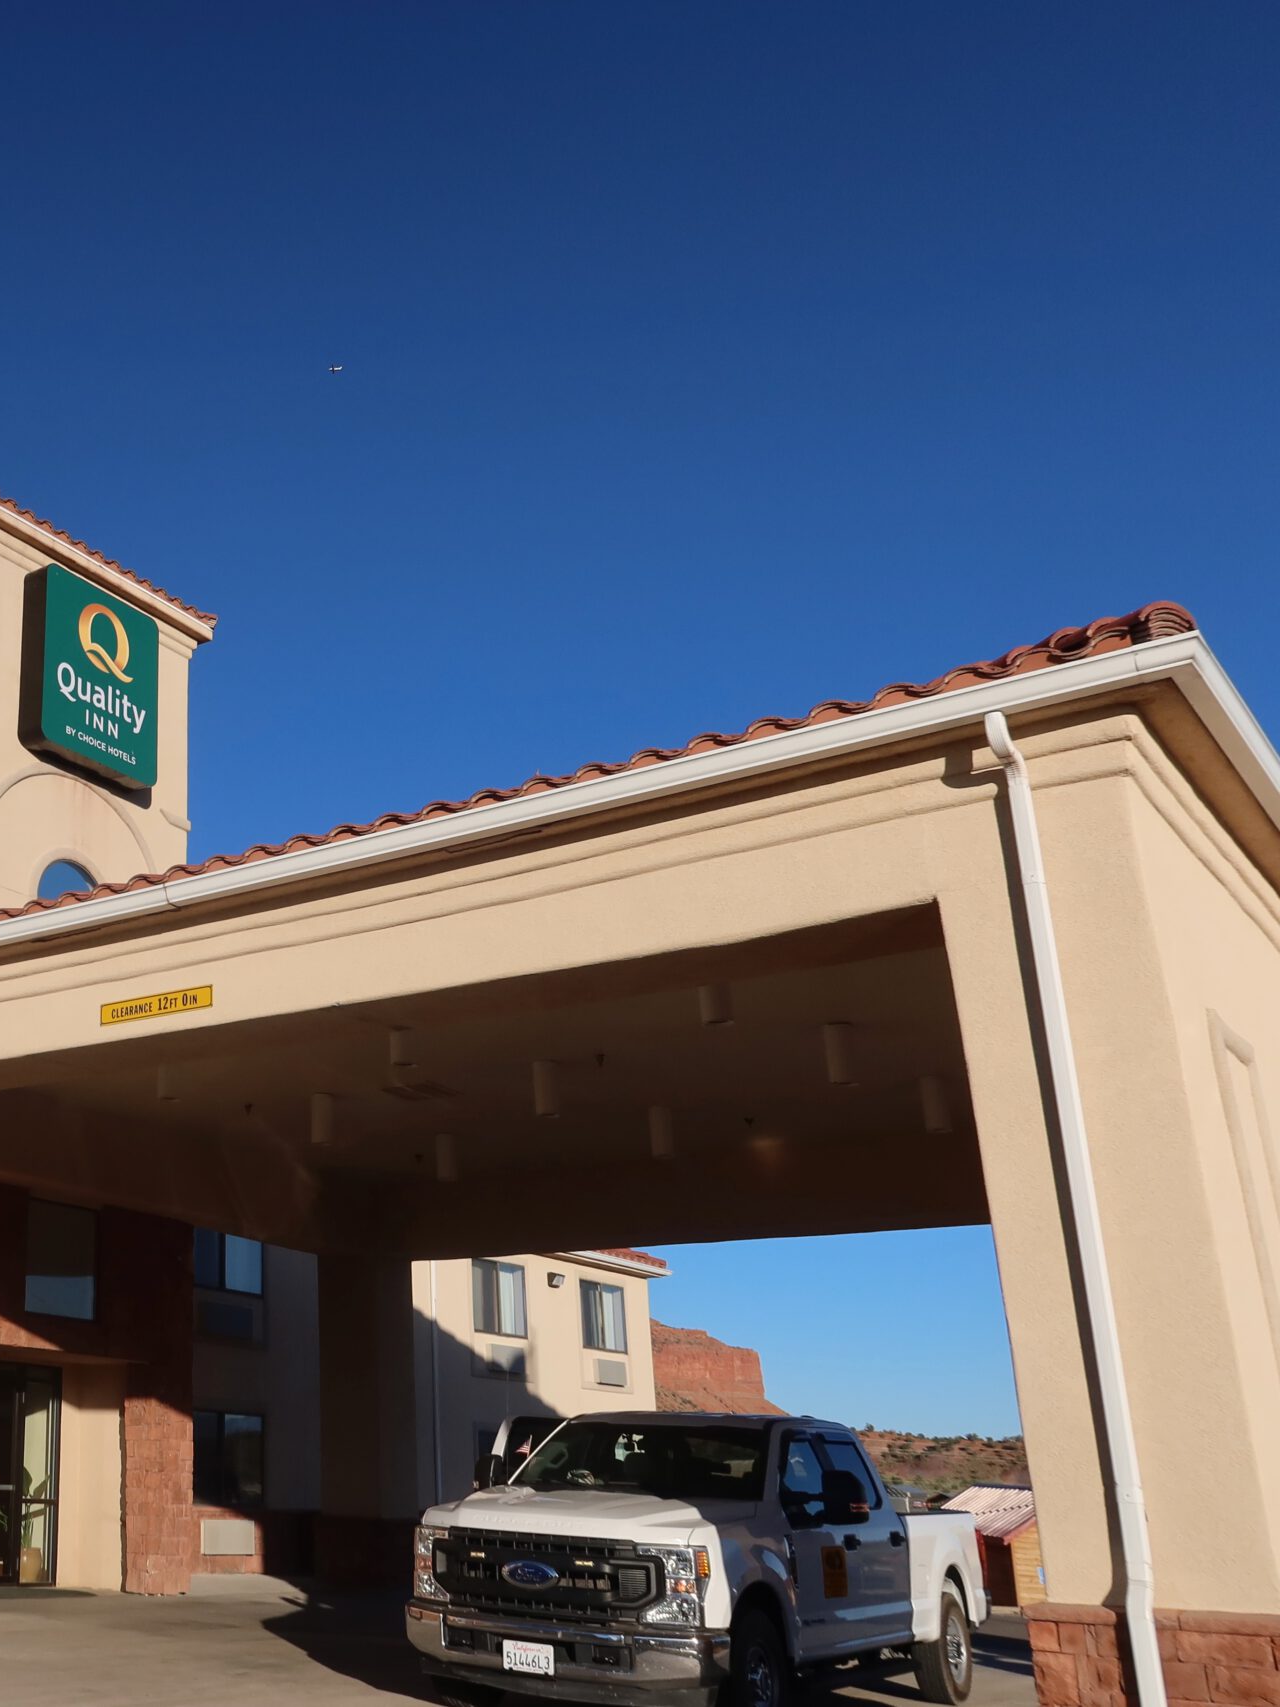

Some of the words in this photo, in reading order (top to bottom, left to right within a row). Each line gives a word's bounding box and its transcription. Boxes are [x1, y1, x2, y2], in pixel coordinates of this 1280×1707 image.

[78, 603, 134, 683] Q
[57, 662, 146, 734] Quality
[85, 708, 119, 740] INN
[65, 725, 77, 737] BY
[77, 731, 107, 752] CHOICE
[107, 745, 137, 765] HOTELS
[111, 1002, 153, 1020] CLEARANCE
[506, 1651, 550, 1670] 51446L3
